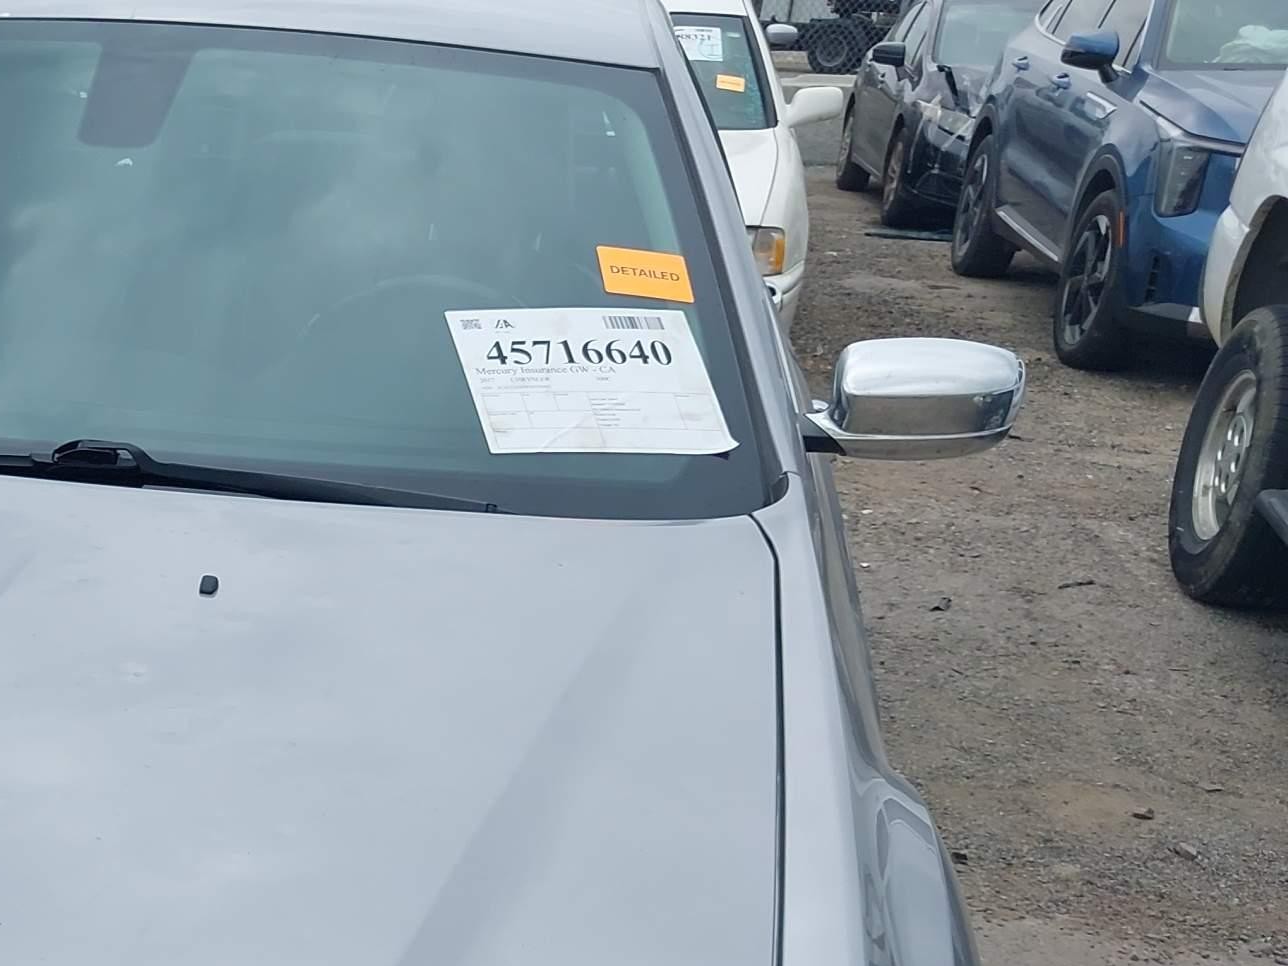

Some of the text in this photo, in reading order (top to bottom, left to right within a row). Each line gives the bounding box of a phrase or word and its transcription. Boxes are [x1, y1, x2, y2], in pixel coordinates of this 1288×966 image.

[609, 264, 681, 283] DETAILED
[486, 338, 673, 366] 45716640
[475, 367, 518, 376] Mercury
[520, 366, 568, 374] Insurance
[570, 365, 589, 373] GW
[599, 365, 616, 374] CA
